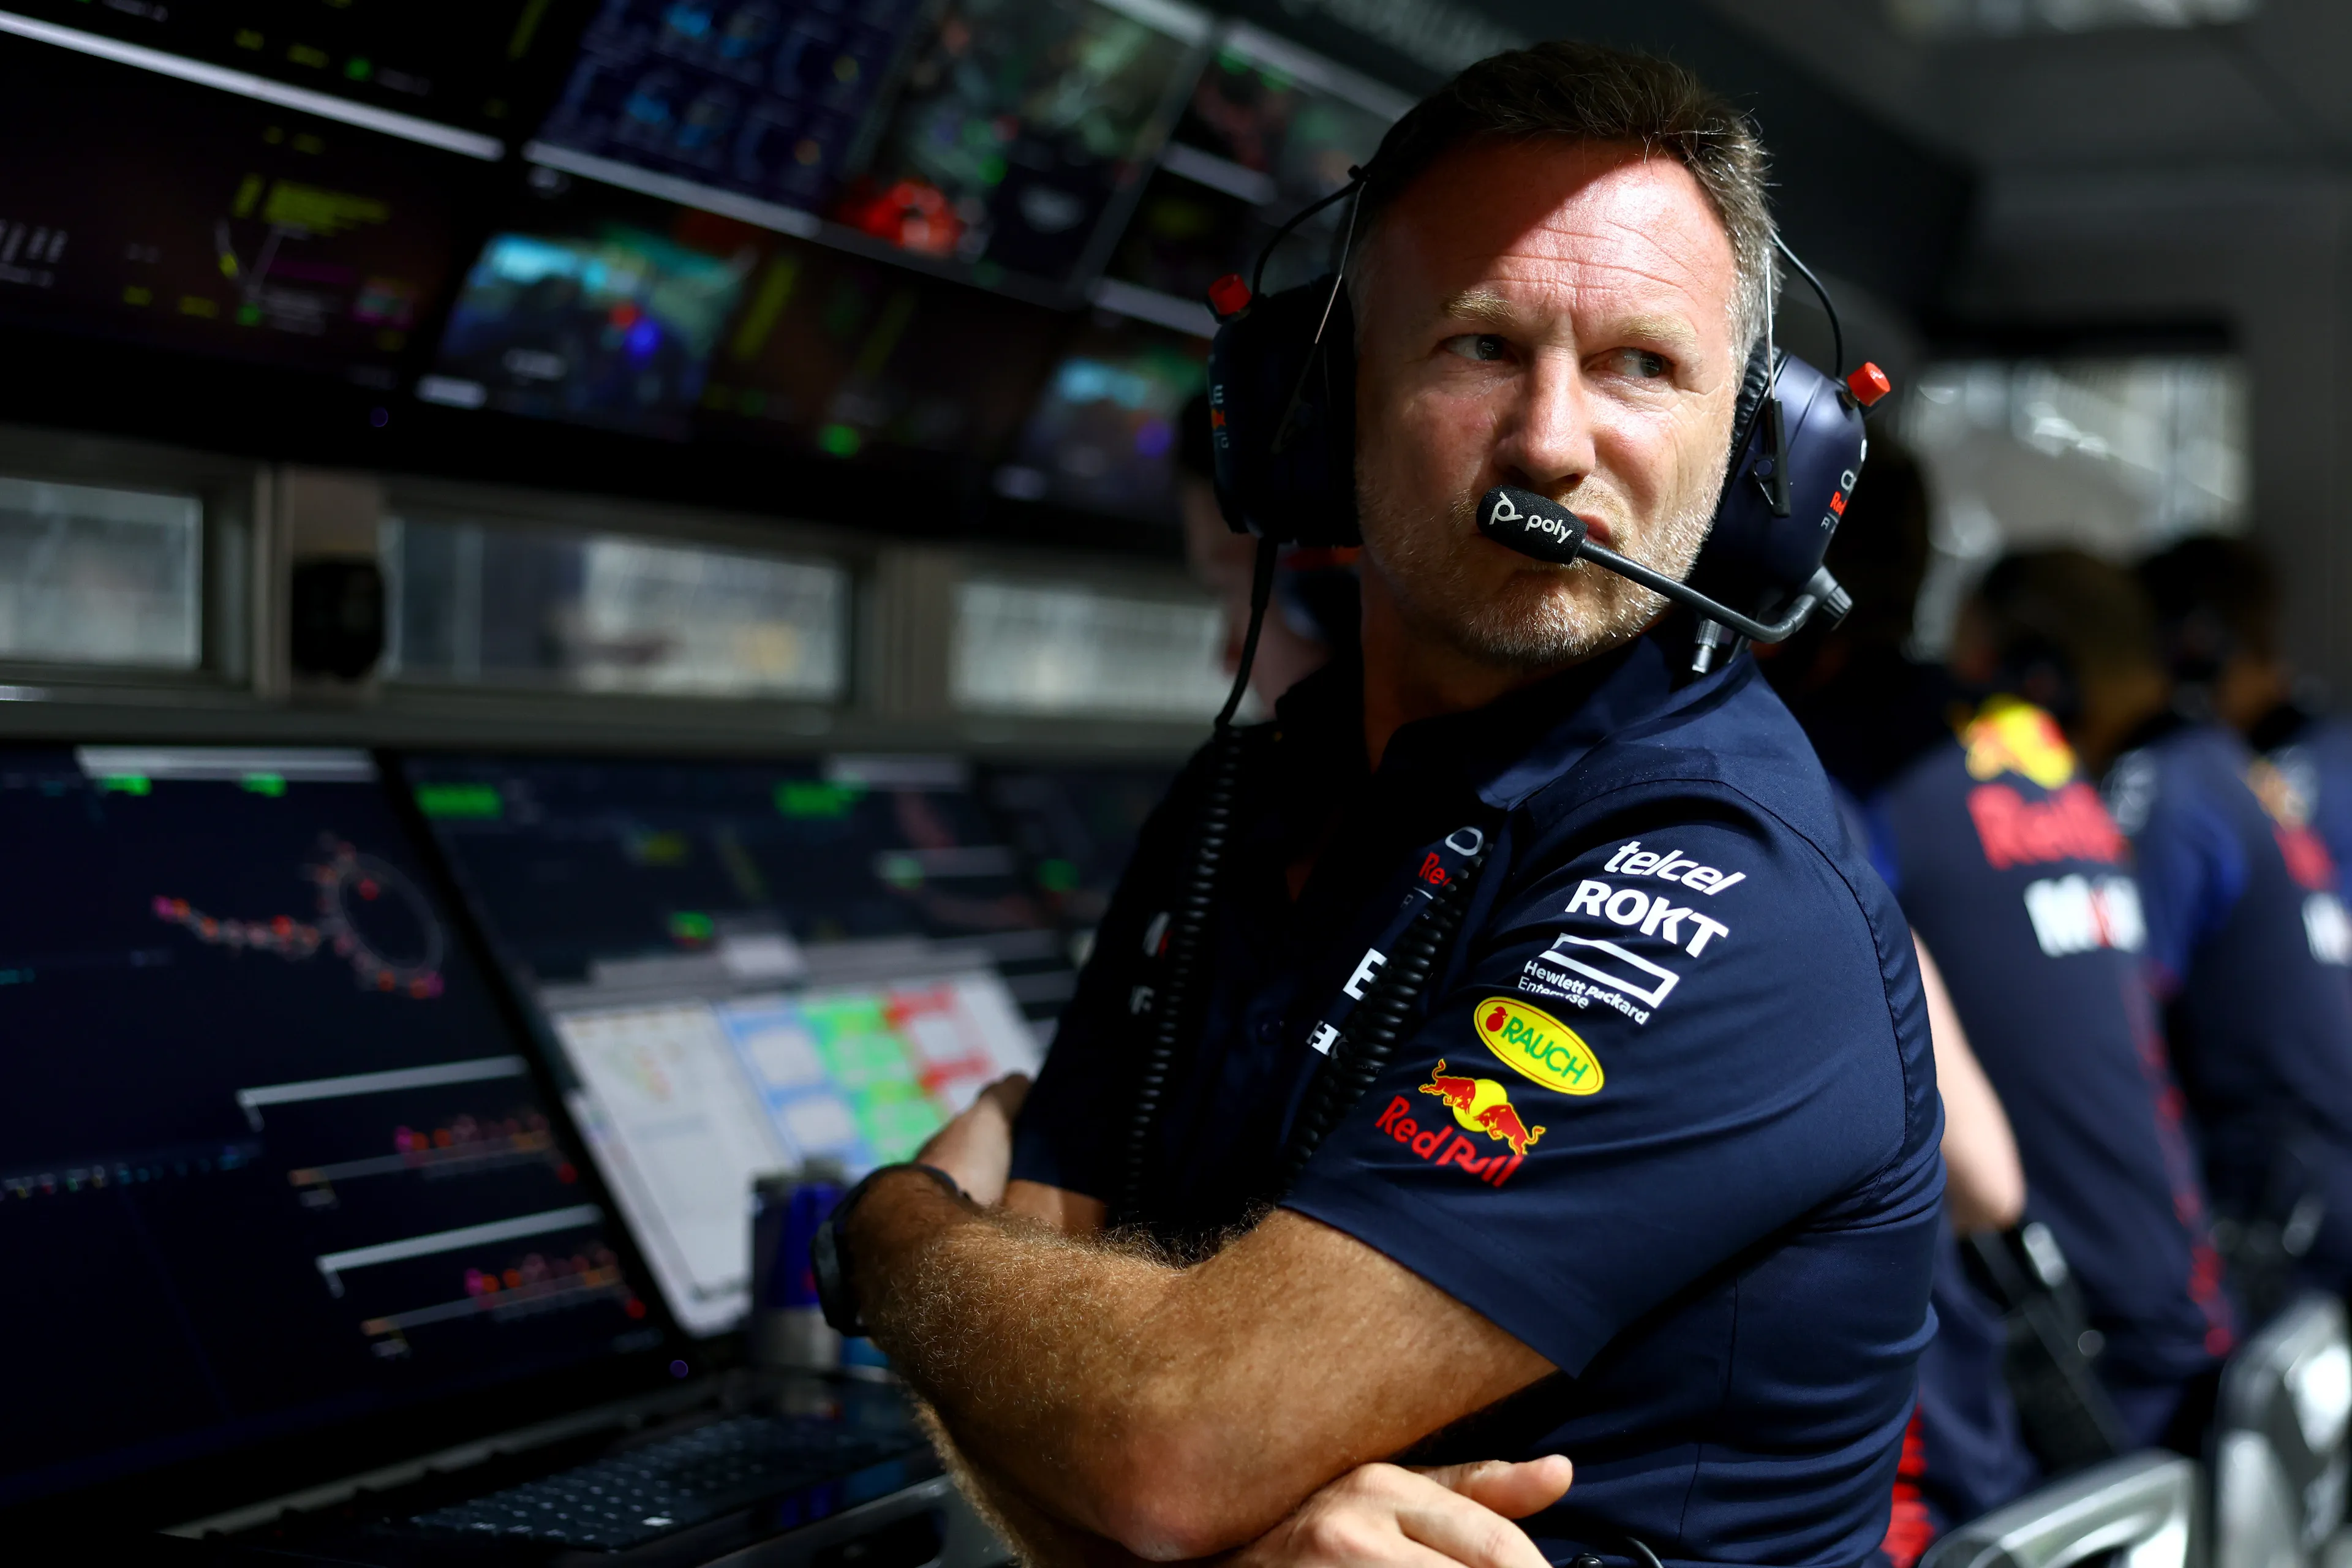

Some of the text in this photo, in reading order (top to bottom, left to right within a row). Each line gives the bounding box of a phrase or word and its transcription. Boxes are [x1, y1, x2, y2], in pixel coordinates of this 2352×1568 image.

[1525, 515, 1573, 544] poly
[1604, 841, 1746, 895] telcel
[1564, 880, 1729, 958] ROKT
[1517, 976, 1589, 1009] Enterise
[1523, 960, 1650, 1025] Hewlett Packard
[1501, 1016, 1589, 1084] RAUCH
[1374, 1095, 1455, 1160] Red
